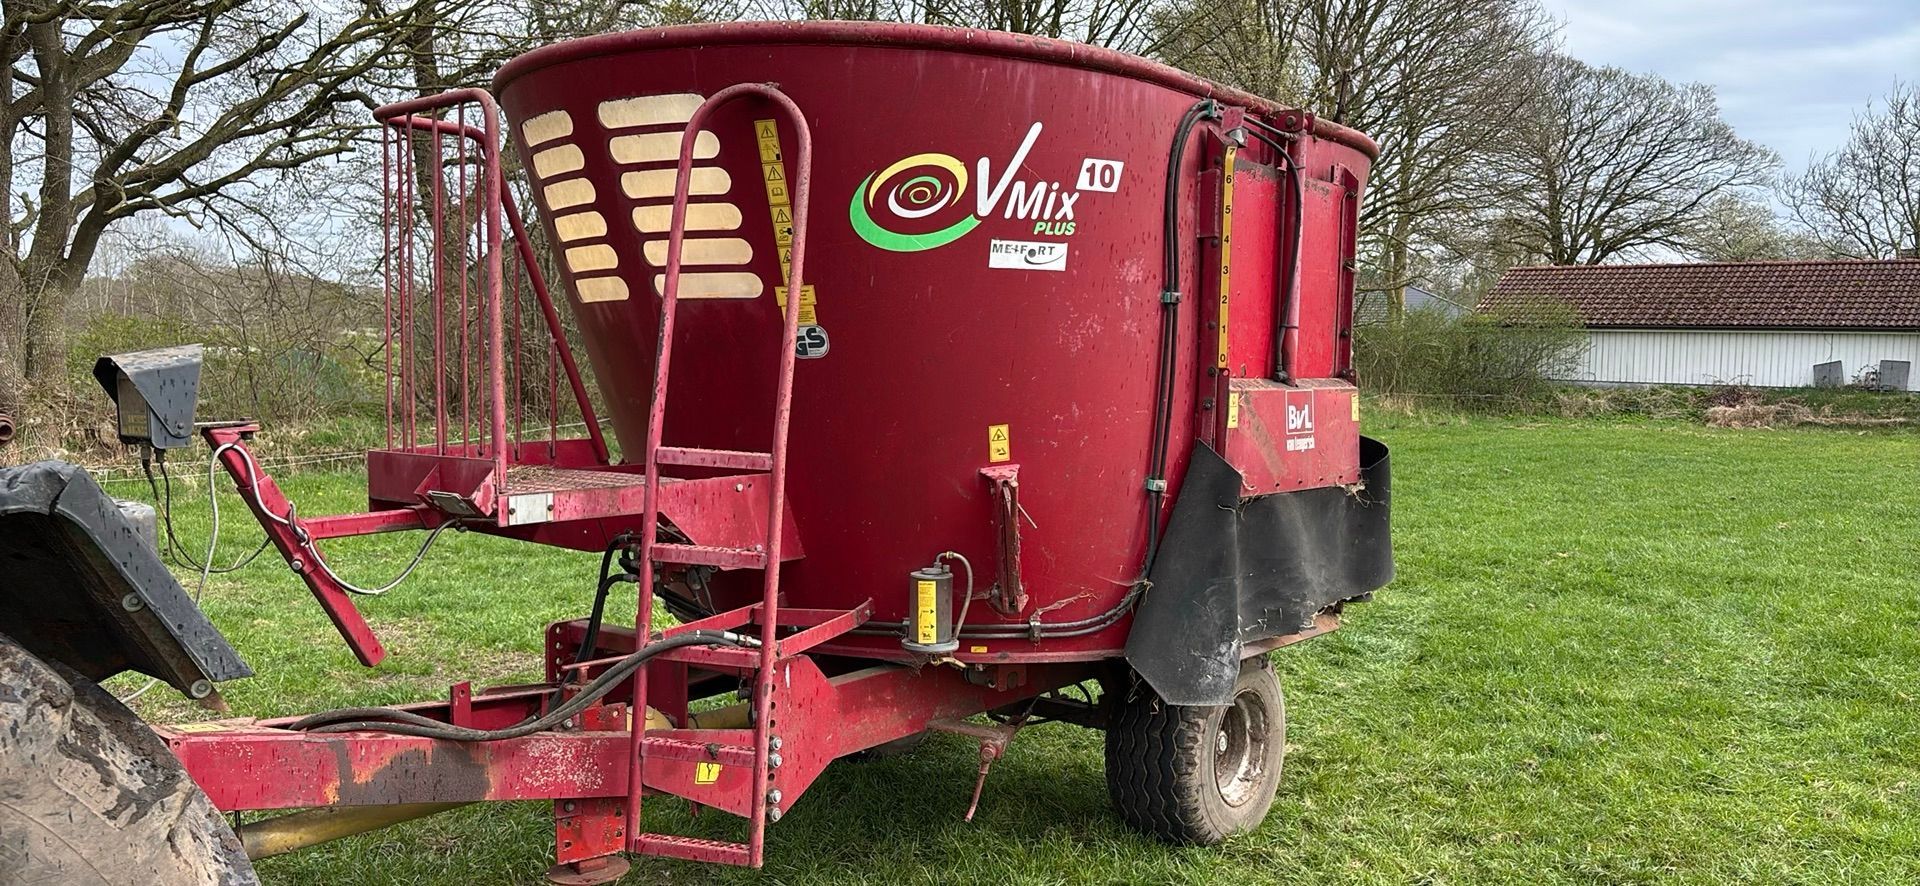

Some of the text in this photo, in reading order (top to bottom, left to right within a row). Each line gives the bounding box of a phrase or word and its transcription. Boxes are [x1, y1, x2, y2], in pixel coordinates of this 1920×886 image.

[1229, 147, 1236, 156] 7
[976, 121, 1080, 220] VMix
[1085, 162, 1115, 189] 10
[1225, 174, 1232, 184] 6
[1225, 204, 1231, 214] 5
[1033, 221, 1077, 236] PLUS
[1223, 235, 1229, 244] 4
[1222, 265, 1229, 275] 3
[1221, 295, 1228, 304] 2
[1221, 324, 1226, 334] 1
[1219, 353, 1226, 362] 0
